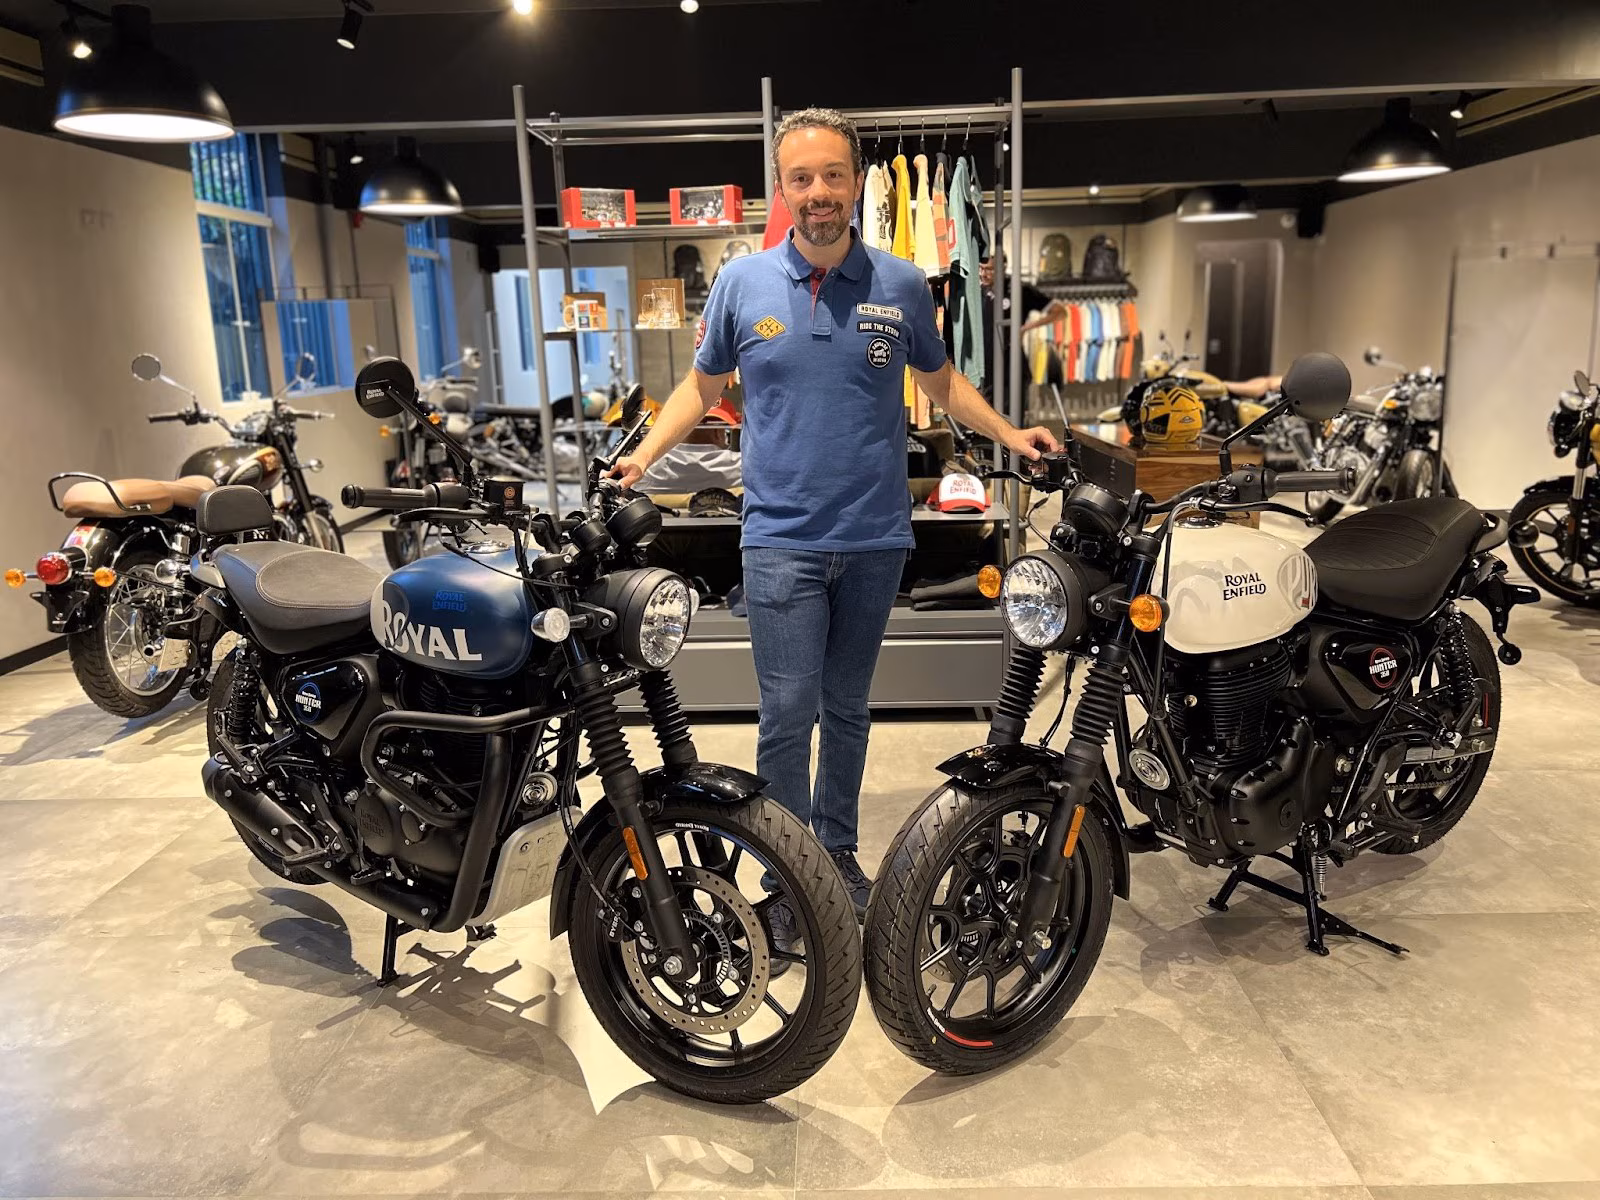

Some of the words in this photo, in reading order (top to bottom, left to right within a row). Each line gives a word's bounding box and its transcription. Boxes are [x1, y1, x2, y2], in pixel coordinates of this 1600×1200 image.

[861, 305, 879, 314] ROYAL
[880, 309, 900, 319] ENFIELD
[859, 322, 872, 331] RIDE
[873, 322, 884, 332] THE
[952, 479, 974, 488] ROYAL
[1224, 572, 1262, 587] ROYAL
[436, 590, 464, 601] ROYAL
[1223, 583, 1267, 601] ENFIELD
[382, 600, 482, 660] ROYAL
[1369, 659, 1398, 675] HUNTER
[295, 693, 322, 710] HUNTER
